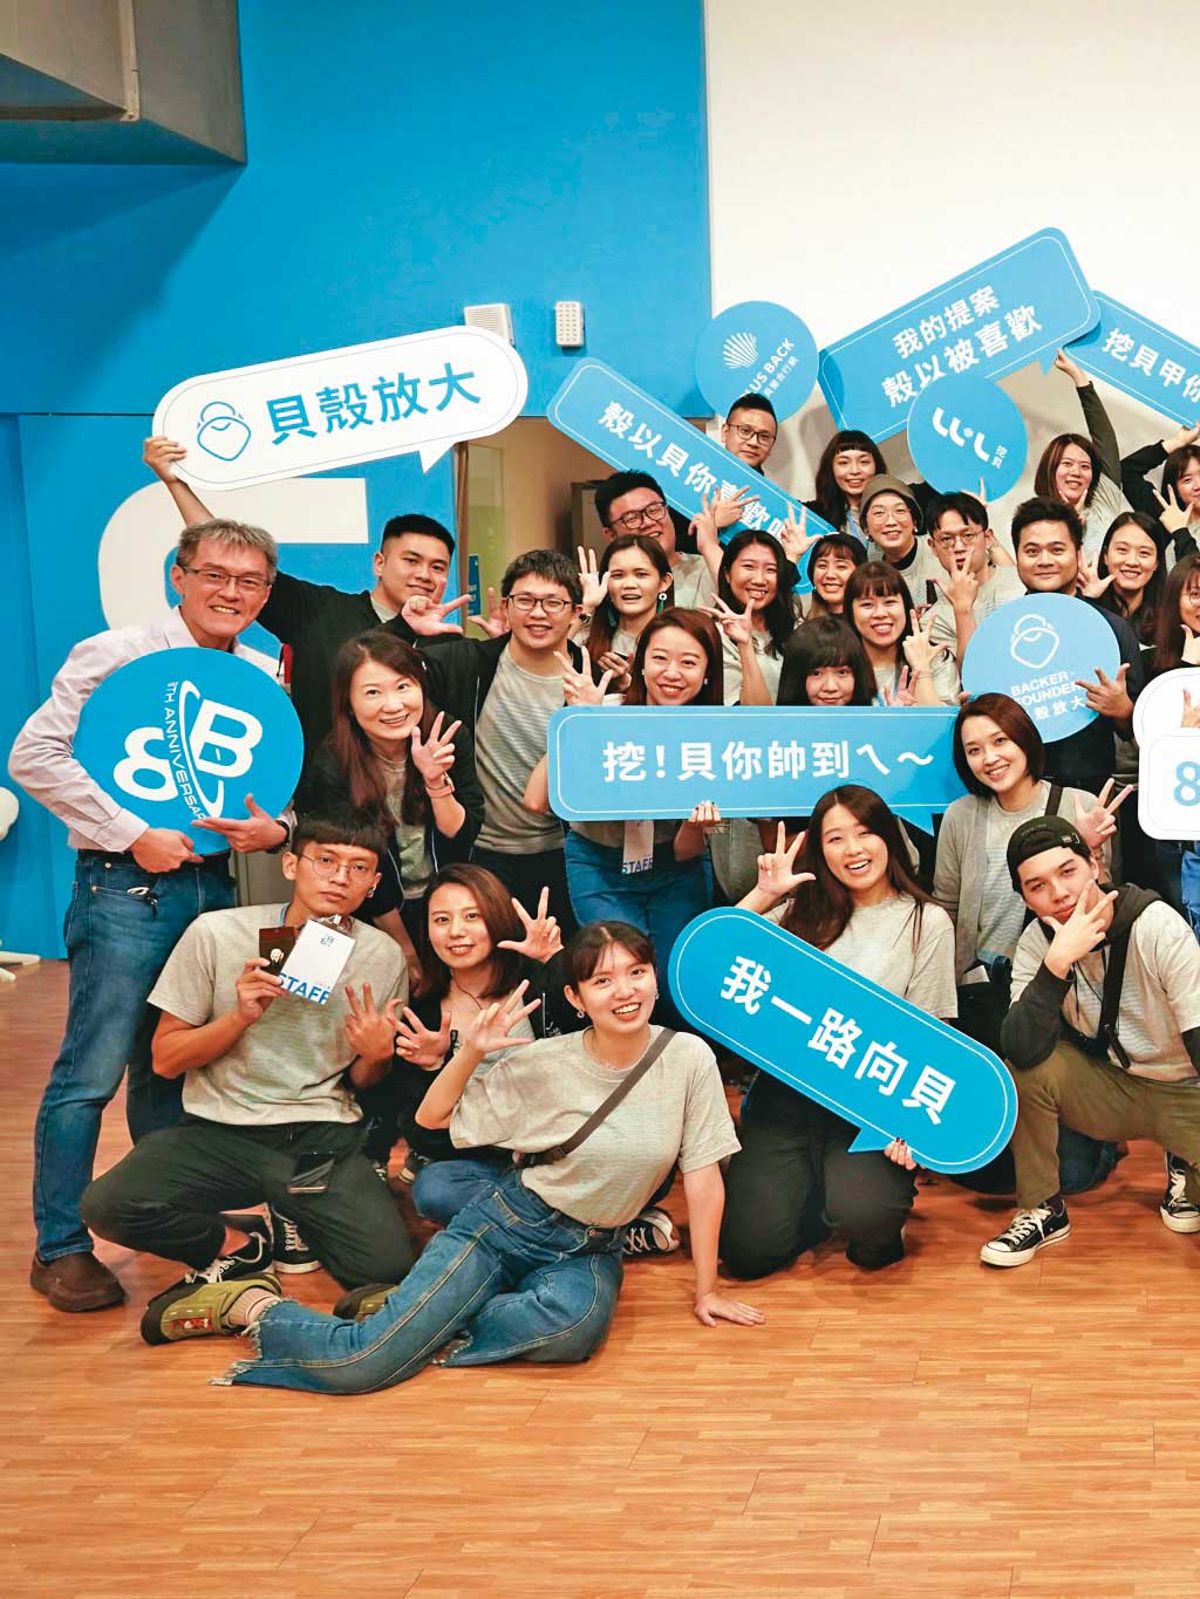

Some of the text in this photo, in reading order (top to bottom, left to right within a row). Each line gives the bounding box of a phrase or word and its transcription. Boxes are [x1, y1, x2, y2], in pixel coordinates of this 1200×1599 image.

[764, 338, 795, 374] BACK
[881, 305, 1042, 408] 殼以被喜歡
[892, 285, 999, 359] 我的提案
[266, 362, 481, 446] 貝殼放大
[1016, 681, 1081, 706] OUNDER
[1034, 695, 1085, 721] 殼放大
[720, 955, 956, 1125] 我一路向貝
